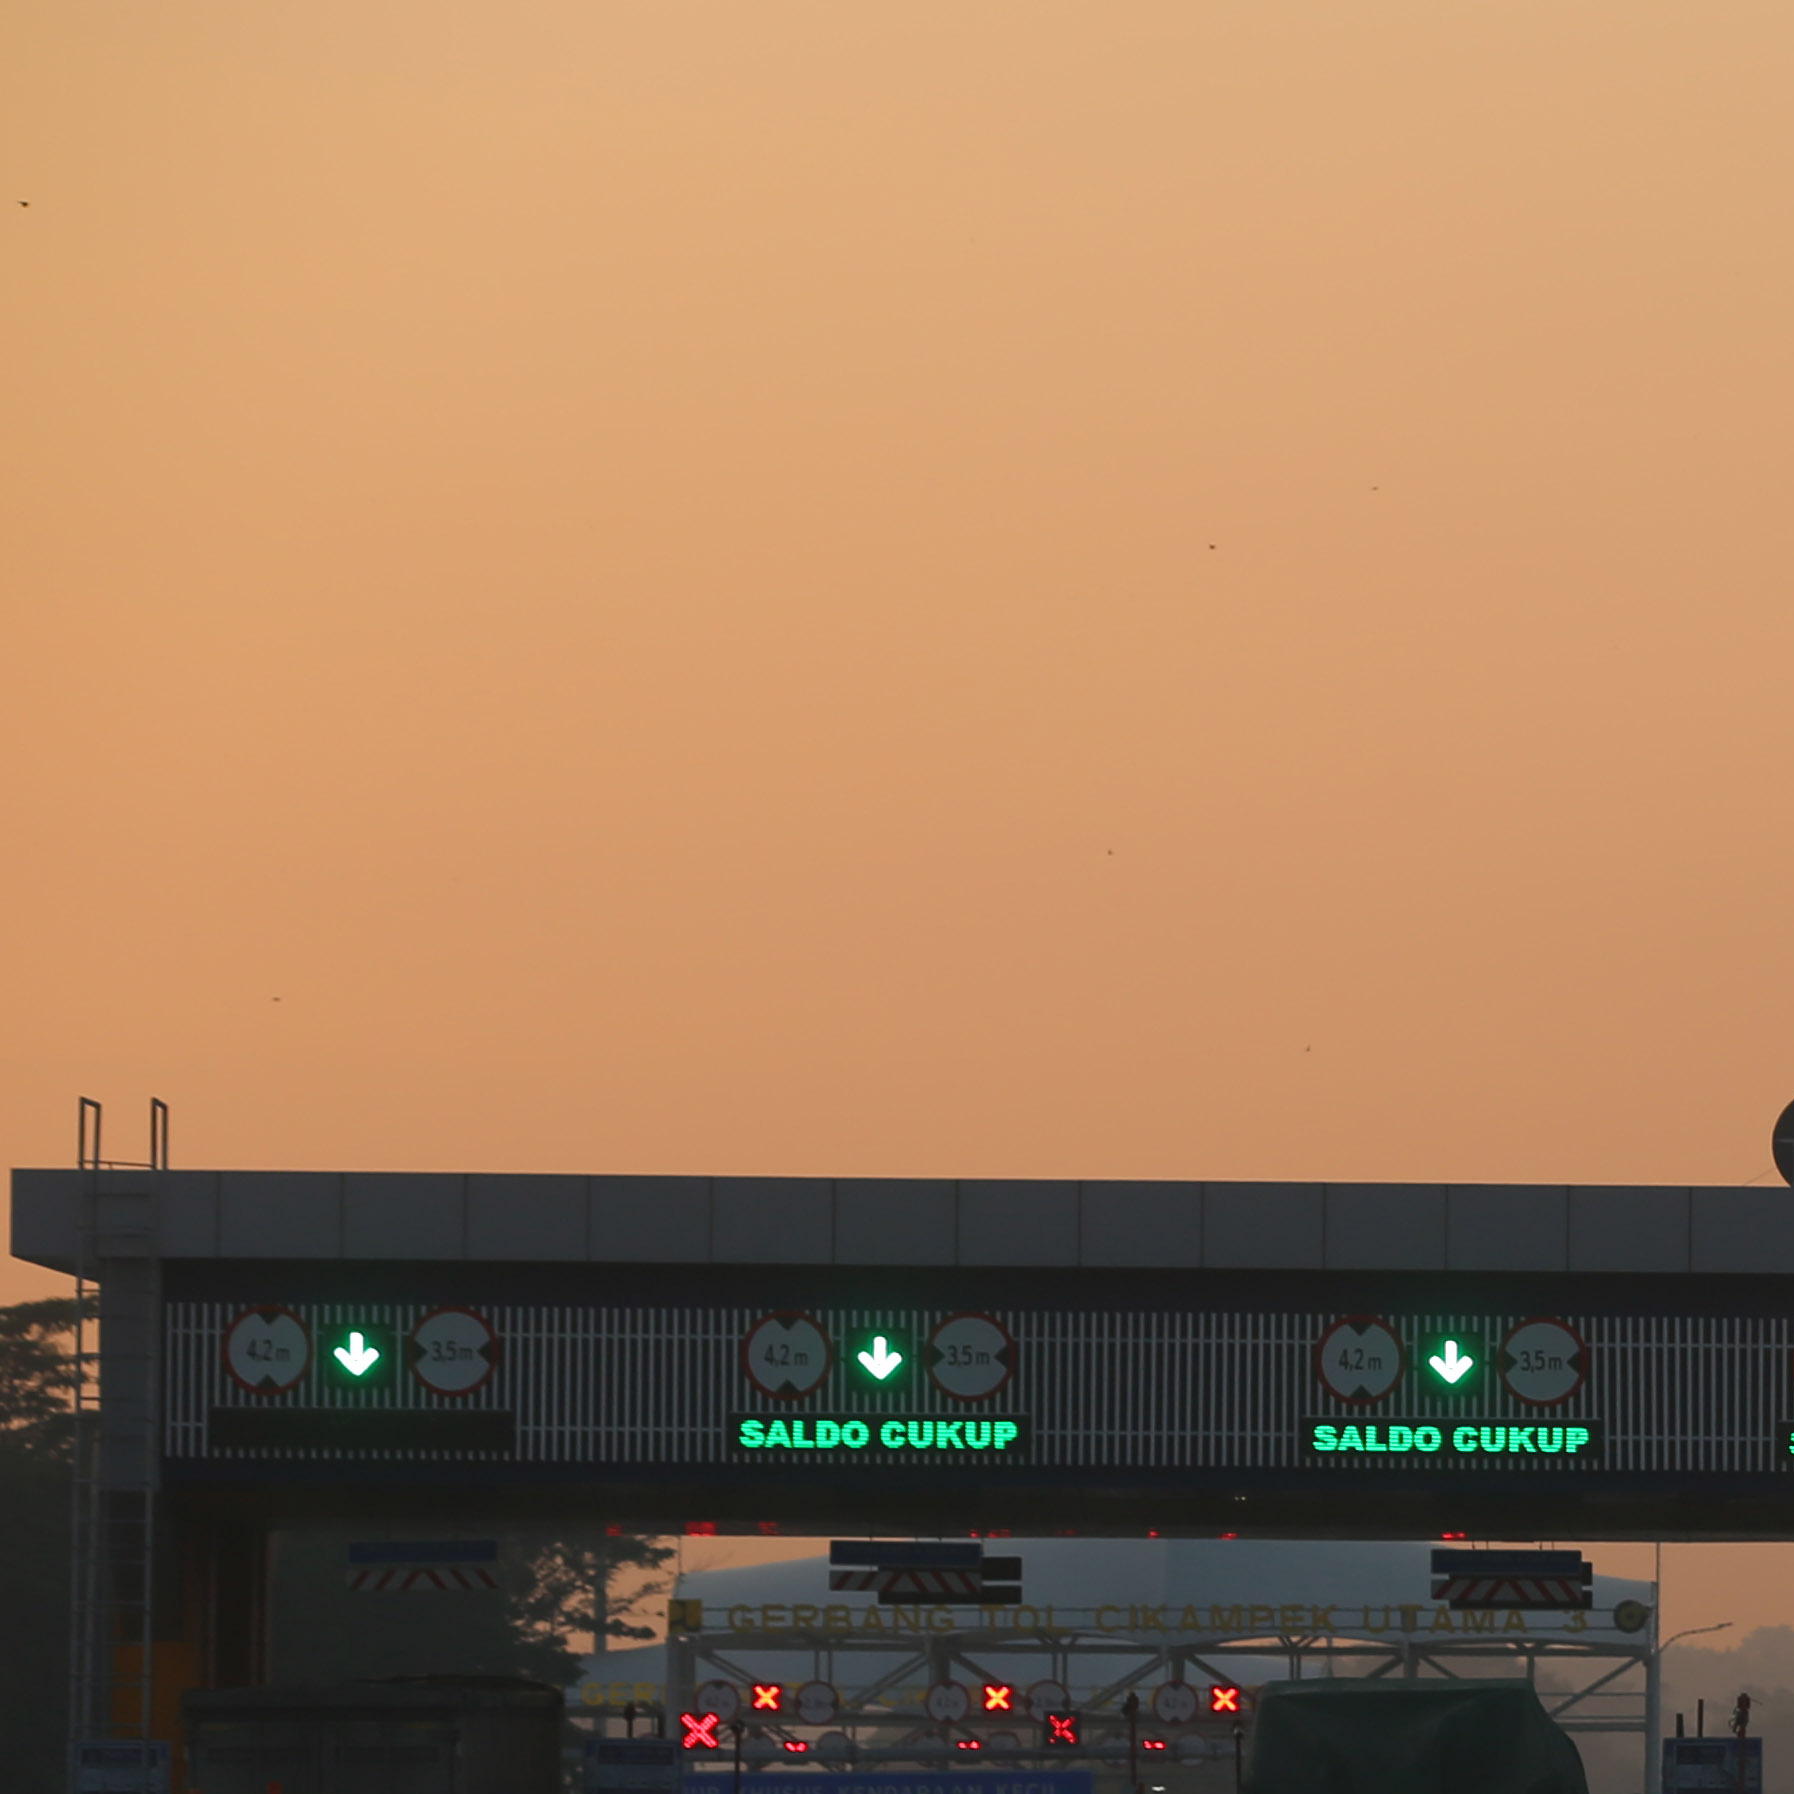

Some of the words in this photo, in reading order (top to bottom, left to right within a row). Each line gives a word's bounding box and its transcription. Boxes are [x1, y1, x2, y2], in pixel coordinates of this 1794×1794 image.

[739, 1420, 869, 1448] SALDO
[881, 1421, 1017, 1449] CUKUP
[1313, 1425, 1442, 1451] SALDO
[1453, 1427, 1589, 1452] CUKUP
[727, 1604, 955, 1634] GERBANG
[981, 1605, 1072, 1635] TOL
[1095, 1604, 1338, 1634] CIKAMPEK
[1363, 1605, 1528, 1634] UTAMA
[1563, 1608, 1589, 1635] 3
